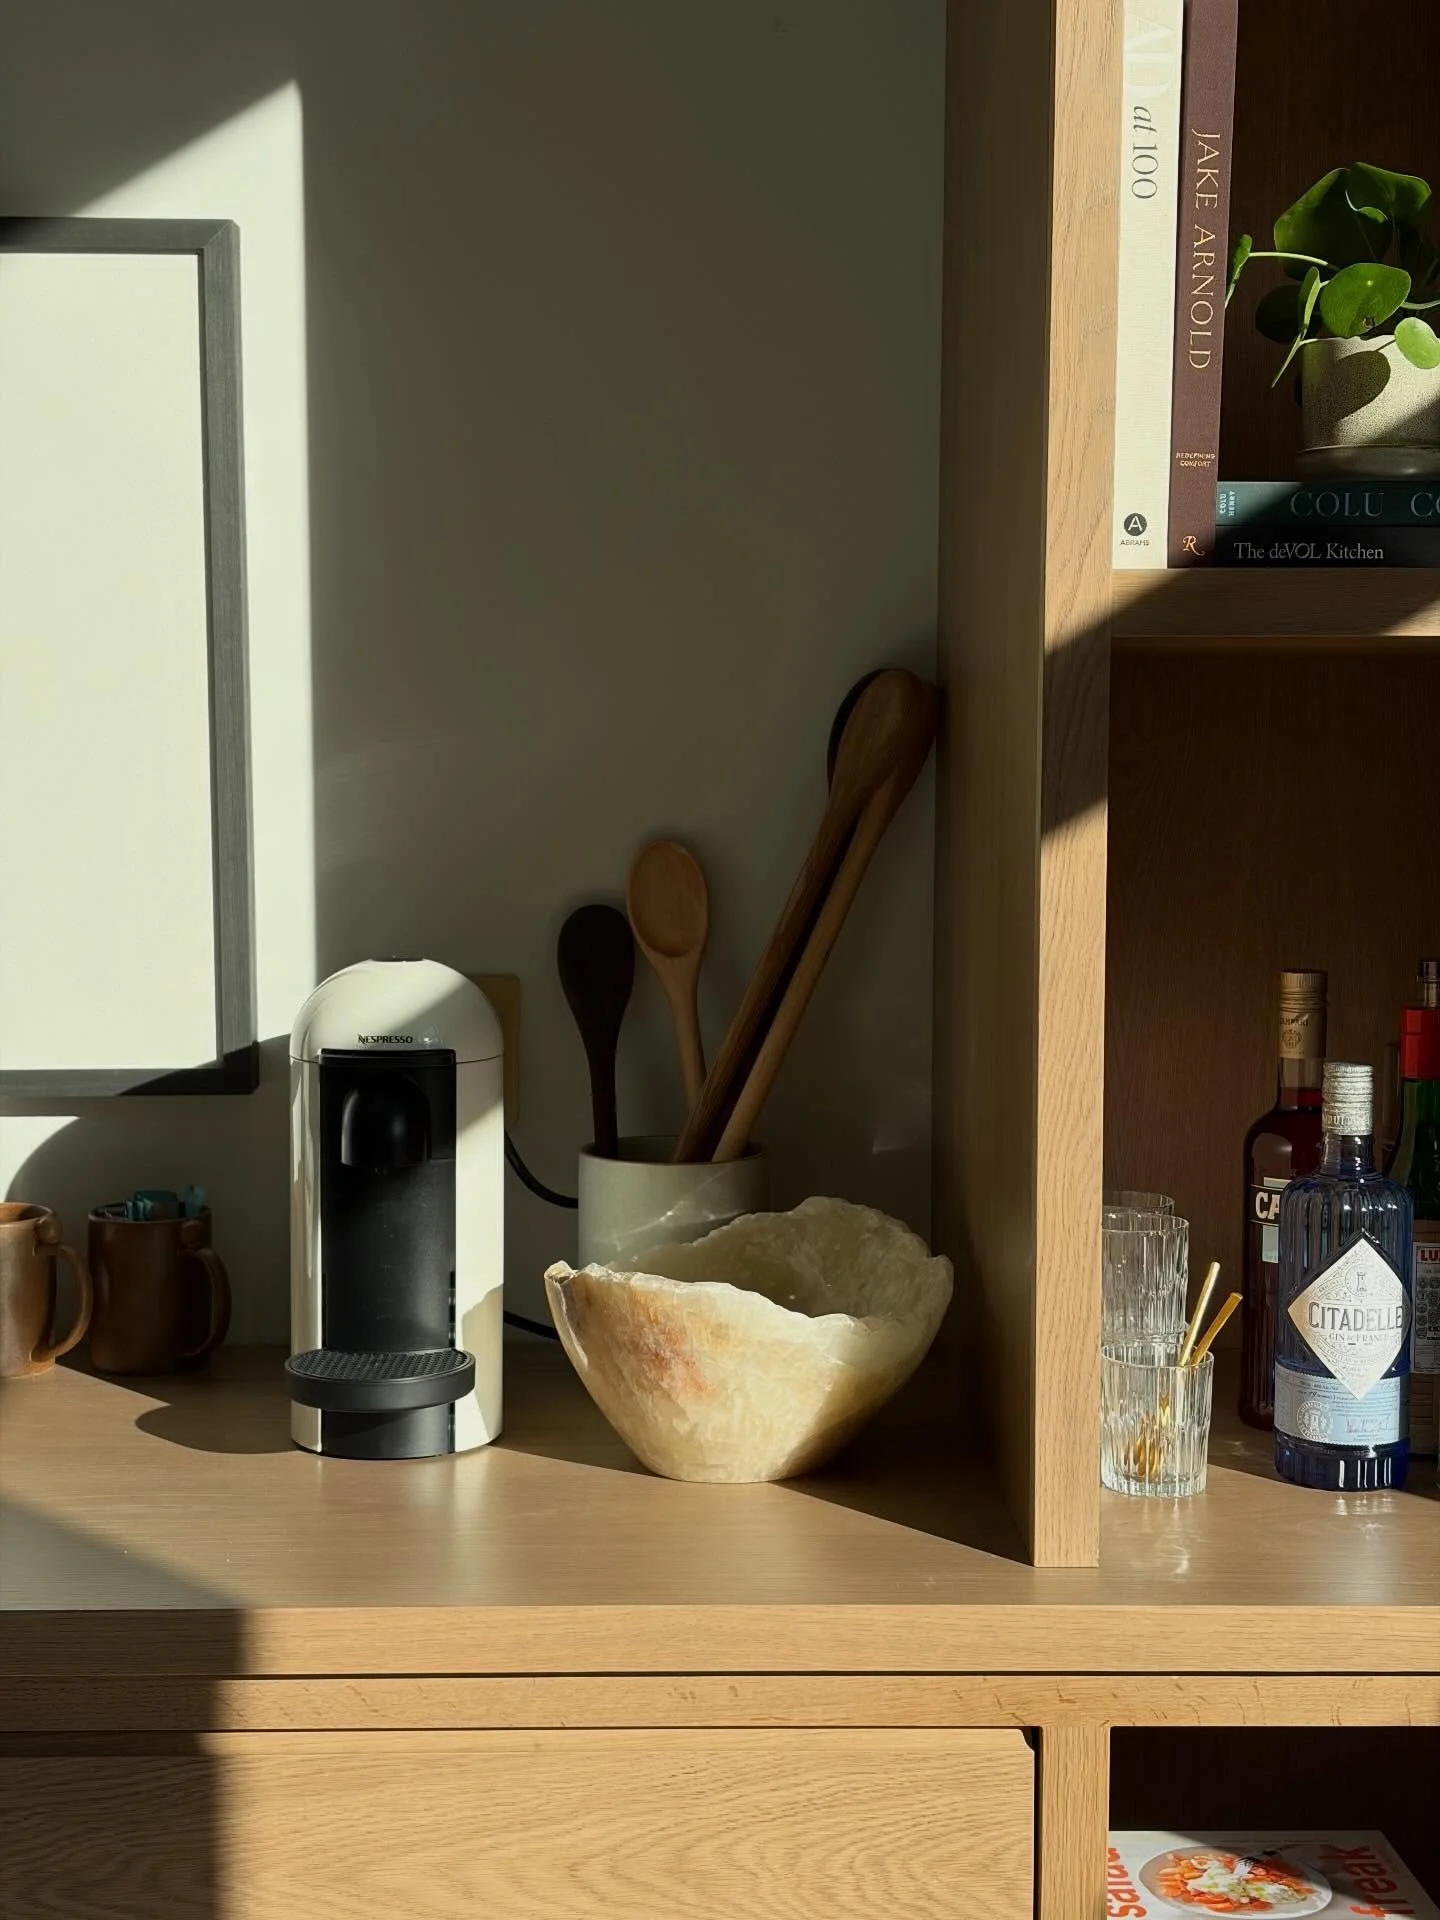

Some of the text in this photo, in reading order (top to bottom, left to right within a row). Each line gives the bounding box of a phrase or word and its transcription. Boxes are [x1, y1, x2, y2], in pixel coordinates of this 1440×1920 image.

[1133, 106, 1158, 133] at
[1131, 143, 1159, 200] 100
[1189, 129, 1221, 369] JAKE ARNOLD
[1290, 491, 1440, 518] COLU C
[1234, 542, 1385, 559] The deVOL Kitchen
[357, 1034, 414, 1045] NESPRESSO
[1420, 1249, 1440, 1262] LU
[1308, 1301, 1403, 1332] CITADELLE
